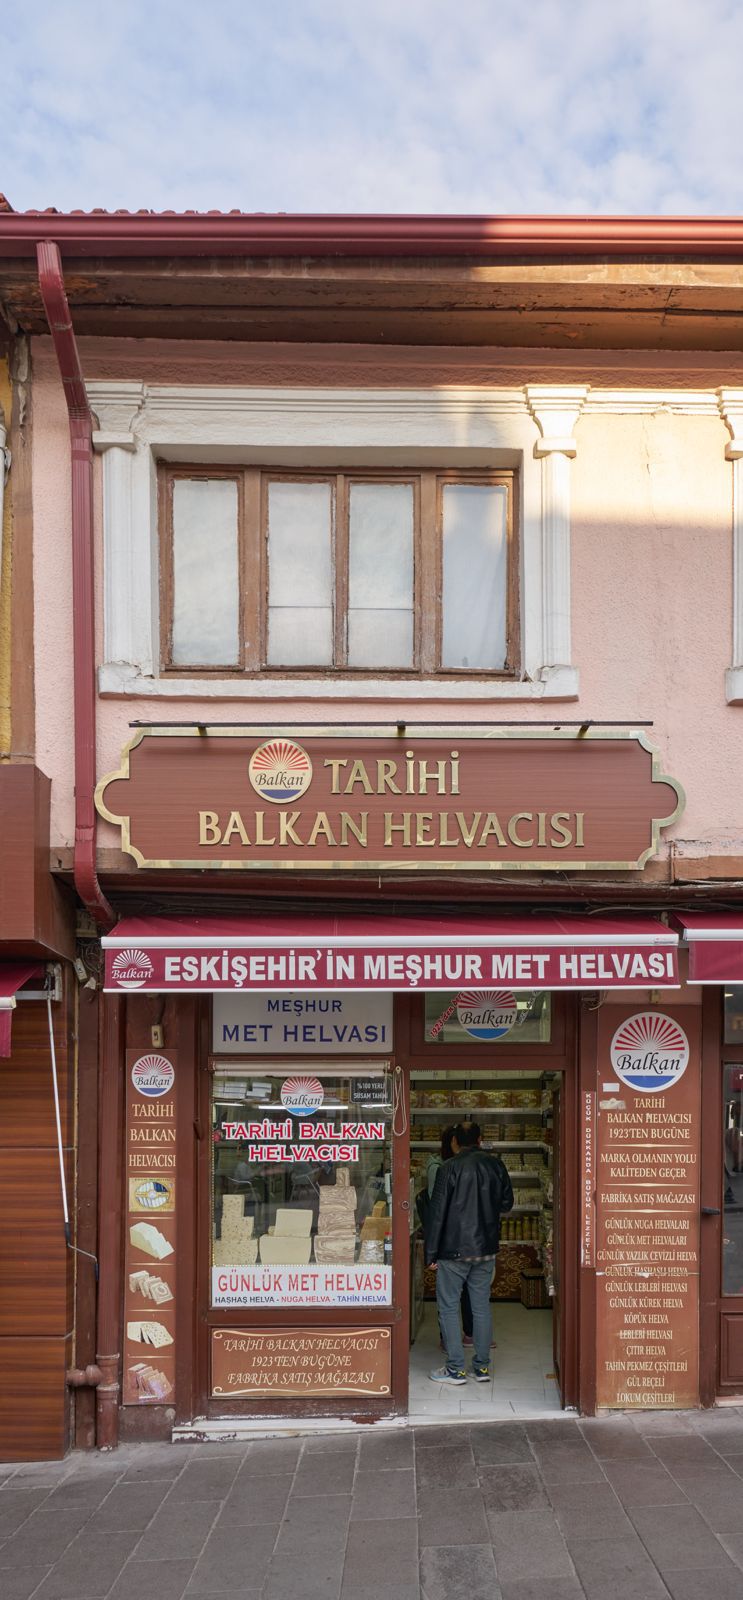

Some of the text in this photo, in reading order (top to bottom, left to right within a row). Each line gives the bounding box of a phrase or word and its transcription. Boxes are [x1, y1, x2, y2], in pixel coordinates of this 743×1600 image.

[323, 750, 460, 795] TARİHİ
[254, 770, 305, 790] Balkan
[198, 811, 586, 848] BALKAN HELVACISI
[111, 967, 152, 980] Balkan
[363, 954, 483, 987] MEŞHUR
[491, 954, 550, 980] MET
[559, 952, 674, 979] HELVASI
[267, 999, 342, 1017] MEŞHUR
[460, 1009, 514, 1028] Balkan
[222, 1024, 386, 1043] MET HELVASI
[617, 1052, 681, 1075] Balkan
[135, 1075, 171, 1088] Balkan
[132, 1101, 174, 1117] TARİHİ
[283, 1095, 322, 1110] Balkan
[633, 1096, 665, 1109] TARİHİ
[607, 1113, 643, 1123] BALKAN
[130, 1128, 176, 1141] BALKAN
[222, 1118, 385, 1140] TARİHİ BALKAN
[651, 1127, 690, 1139] BUGÜNE
[249, 1144, 359, 1162] HELVACISI
[600, 1153, 697, 1163] MARKA OLMANIN YOLU
[128, 1154, 176, 1167] HELVACISI
[610, 1166, 687, 1180] KALİTEDEN GEÇER
[601, 1192, 696, 1205] FABRİKA SATIŞ MAĞAZASI
[605, 1217, 690, 1230] GÜNLÜK NUGA HELVALARI
[607, 1233, 687, 1245] GÜNLÜK MET HELVALARI
[597, 1249, 697, 1261] GÜNLÜK YAZLIK CEVİZLİ HELVA
[218, 1269, 387, 1292] GÜNLÜK MET HELVASI
[605, 1280, 688, 1293] GÜNLÜK LEBLEBİ HELVASI
[215, 1296, 248, 1304] HAŞHAŞ
[305, 1295, 331, 1303] HELVA
[337, 1294, 361, 1303] TAHİN
[363, 1295, 387, 1303] HELVA
[609, 1296, 684, 1308] GÜNLÜK KÜREK HELVA
[624, 1312, 669, 1324] KÖPÜK HELVA
[646, 1330, 673, 1340] HELVASI
[223, 1337, 379, 1351] TARİHİ BALKAN HELVACISI
[626, 1345, 666, 1357] ÇITIR HELVA
[300, 1354, 352, 1369] BUGÜNE
[626, 1361, 653, 1371] PEKMEZ
[227, 1370, 375, 1387] FABRİKA SATIŞ MAĞAZASI
[627, 1375, 665, 1389] GÜL REÇELİ
[616, 1393, 641, 1403] LOKUM
